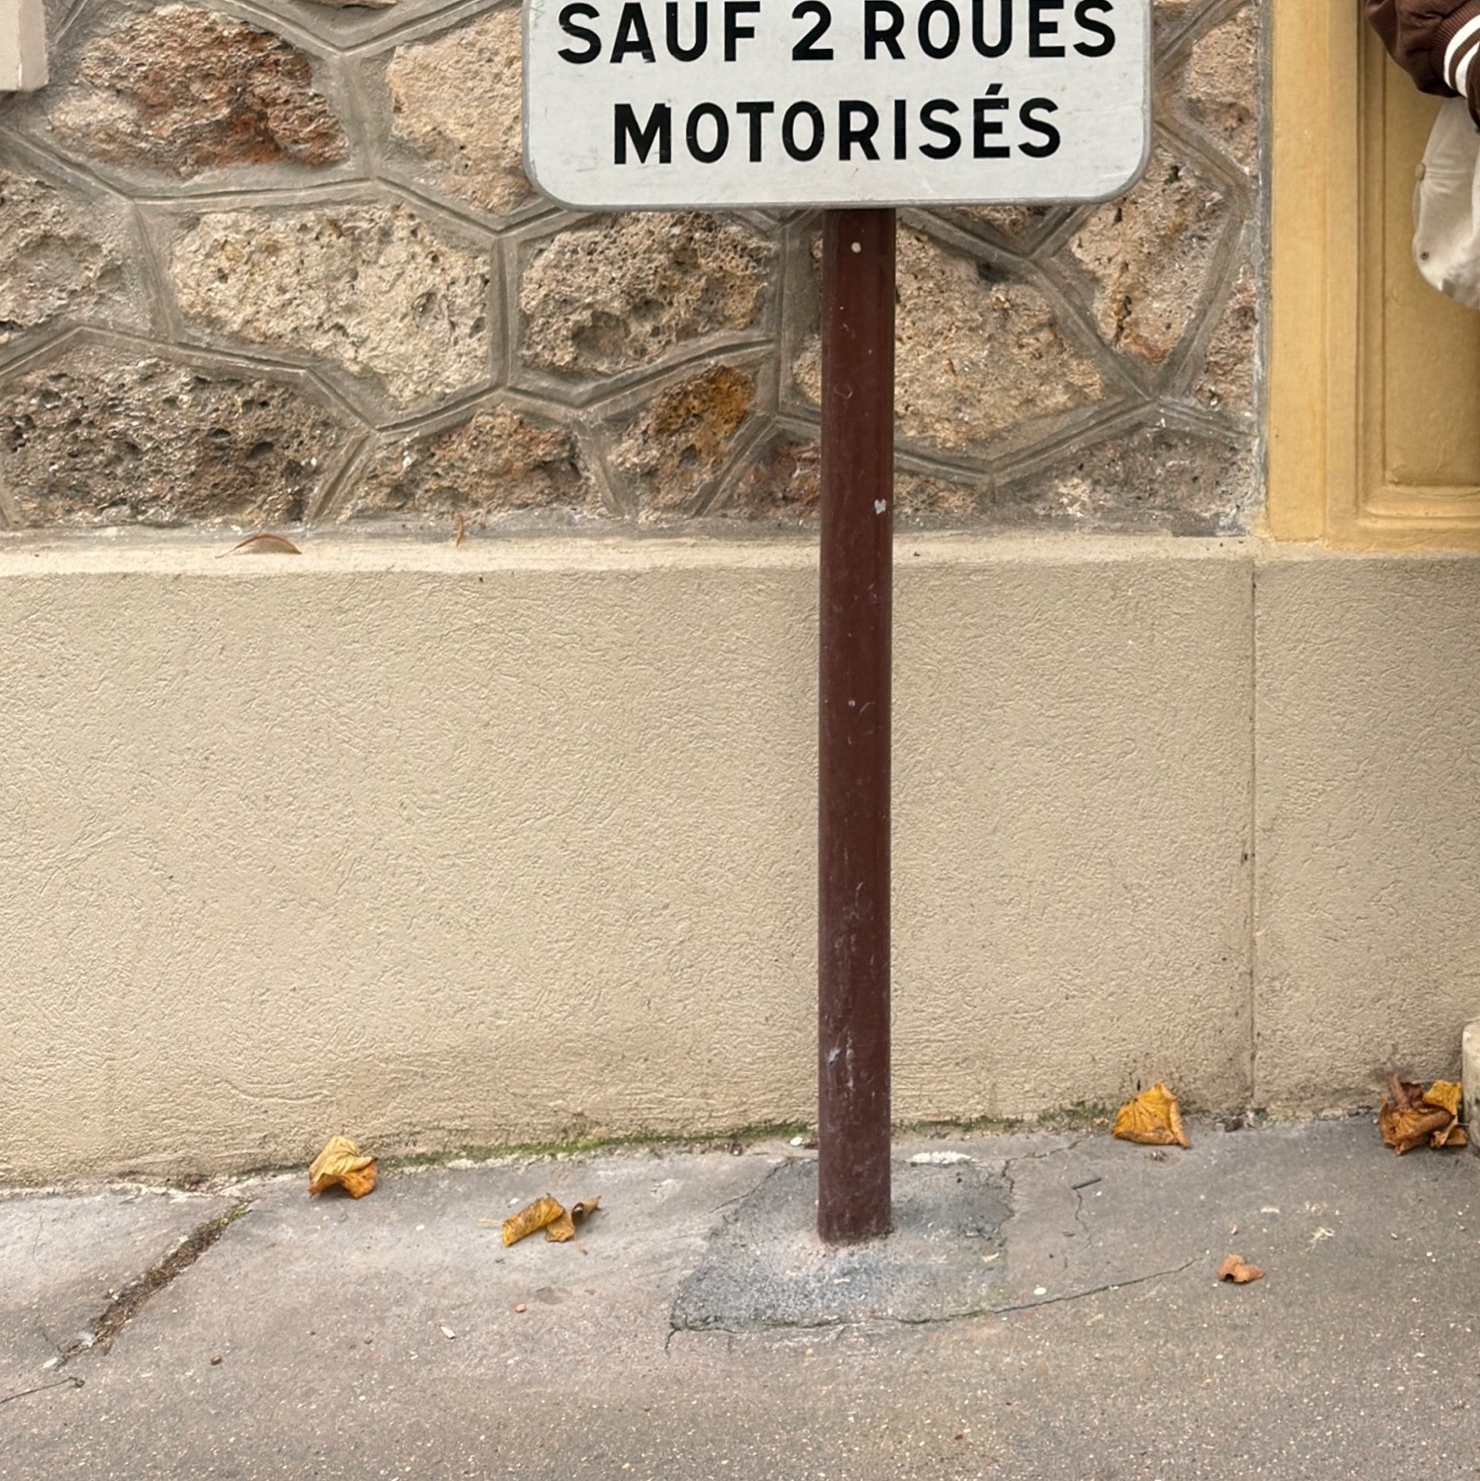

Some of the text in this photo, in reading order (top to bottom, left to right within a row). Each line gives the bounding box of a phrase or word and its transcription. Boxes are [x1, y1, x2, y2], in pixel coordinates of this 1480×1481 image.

[557, 0, 761, 65] SAUF
[791, 0, 834, 61] 2
[613, 83, 1061, 165] MOTORISÉS
